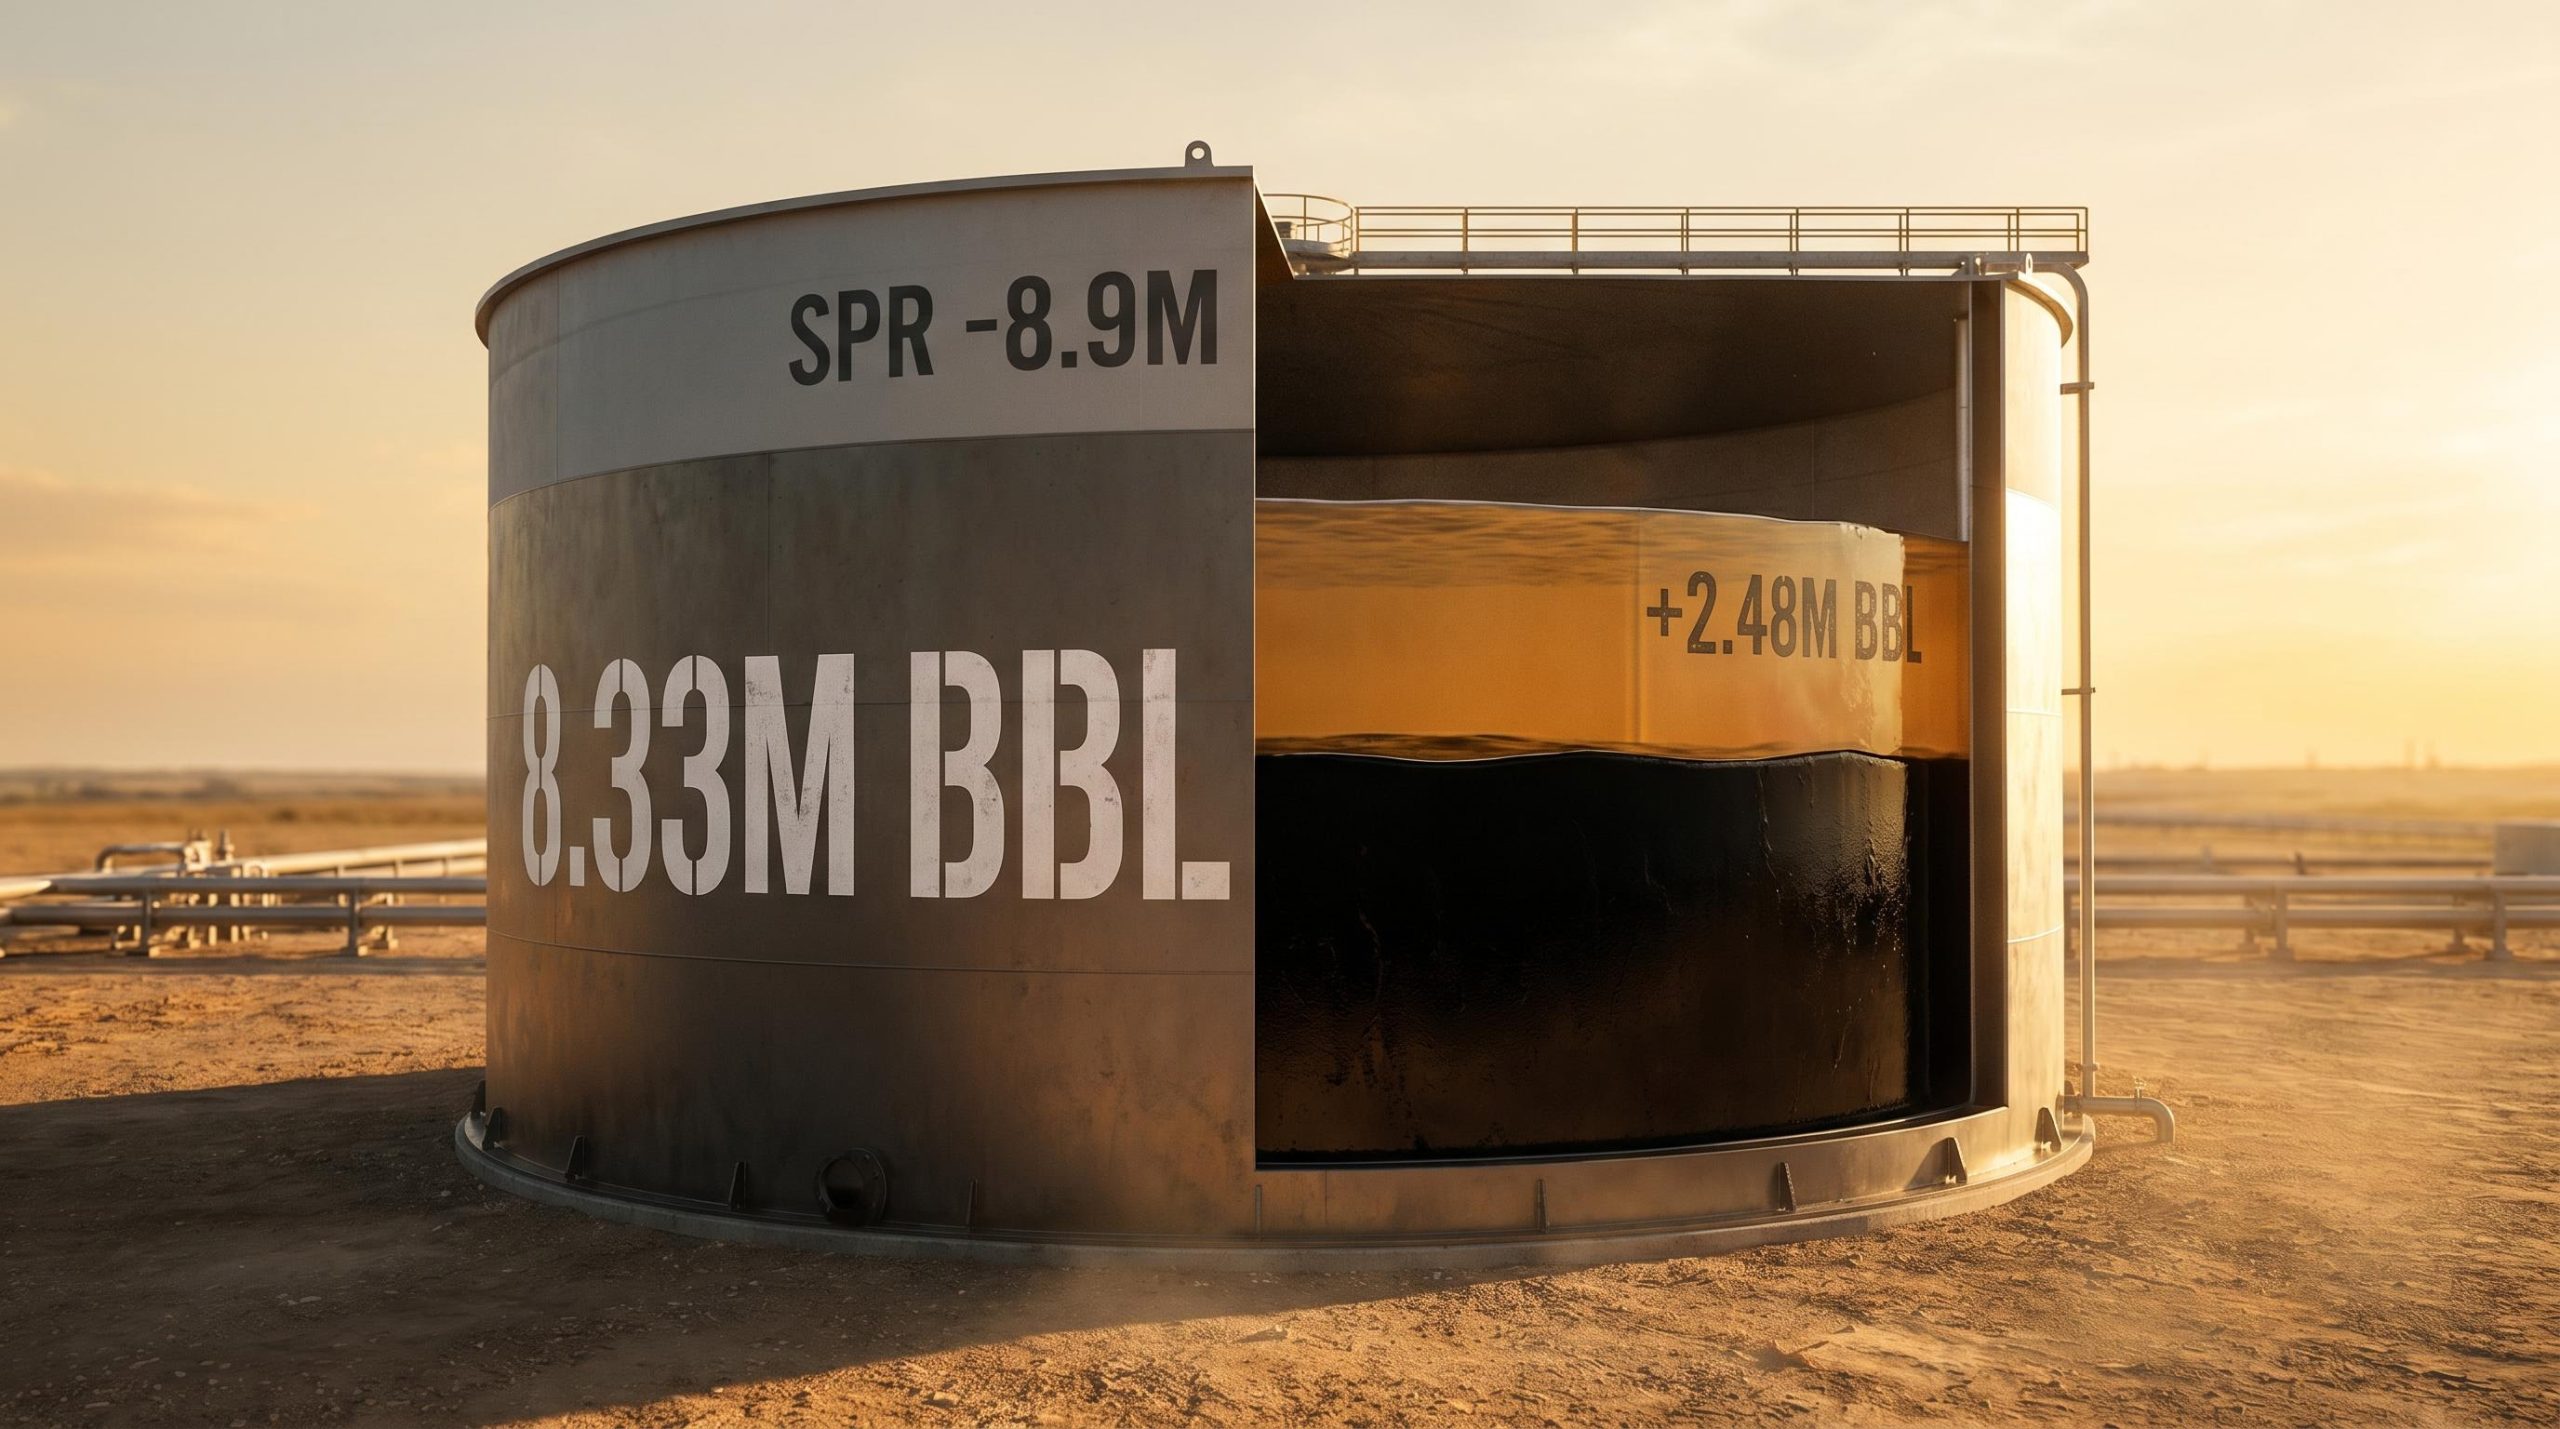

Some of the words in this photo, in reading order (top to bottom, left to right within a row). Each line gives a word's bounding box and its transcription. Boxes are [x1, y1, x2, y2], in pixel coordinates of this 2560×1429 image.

[789, 285, 934, 386] SPR
[966, 269, 1217, 371] -8.9M
[1647, 571, 1837, 658] +2.48M
[1855, 580, 1922, 663] BBL
[522, 653, 855, 896] 8.33M
[910, 648, 1231, 900] BBL
